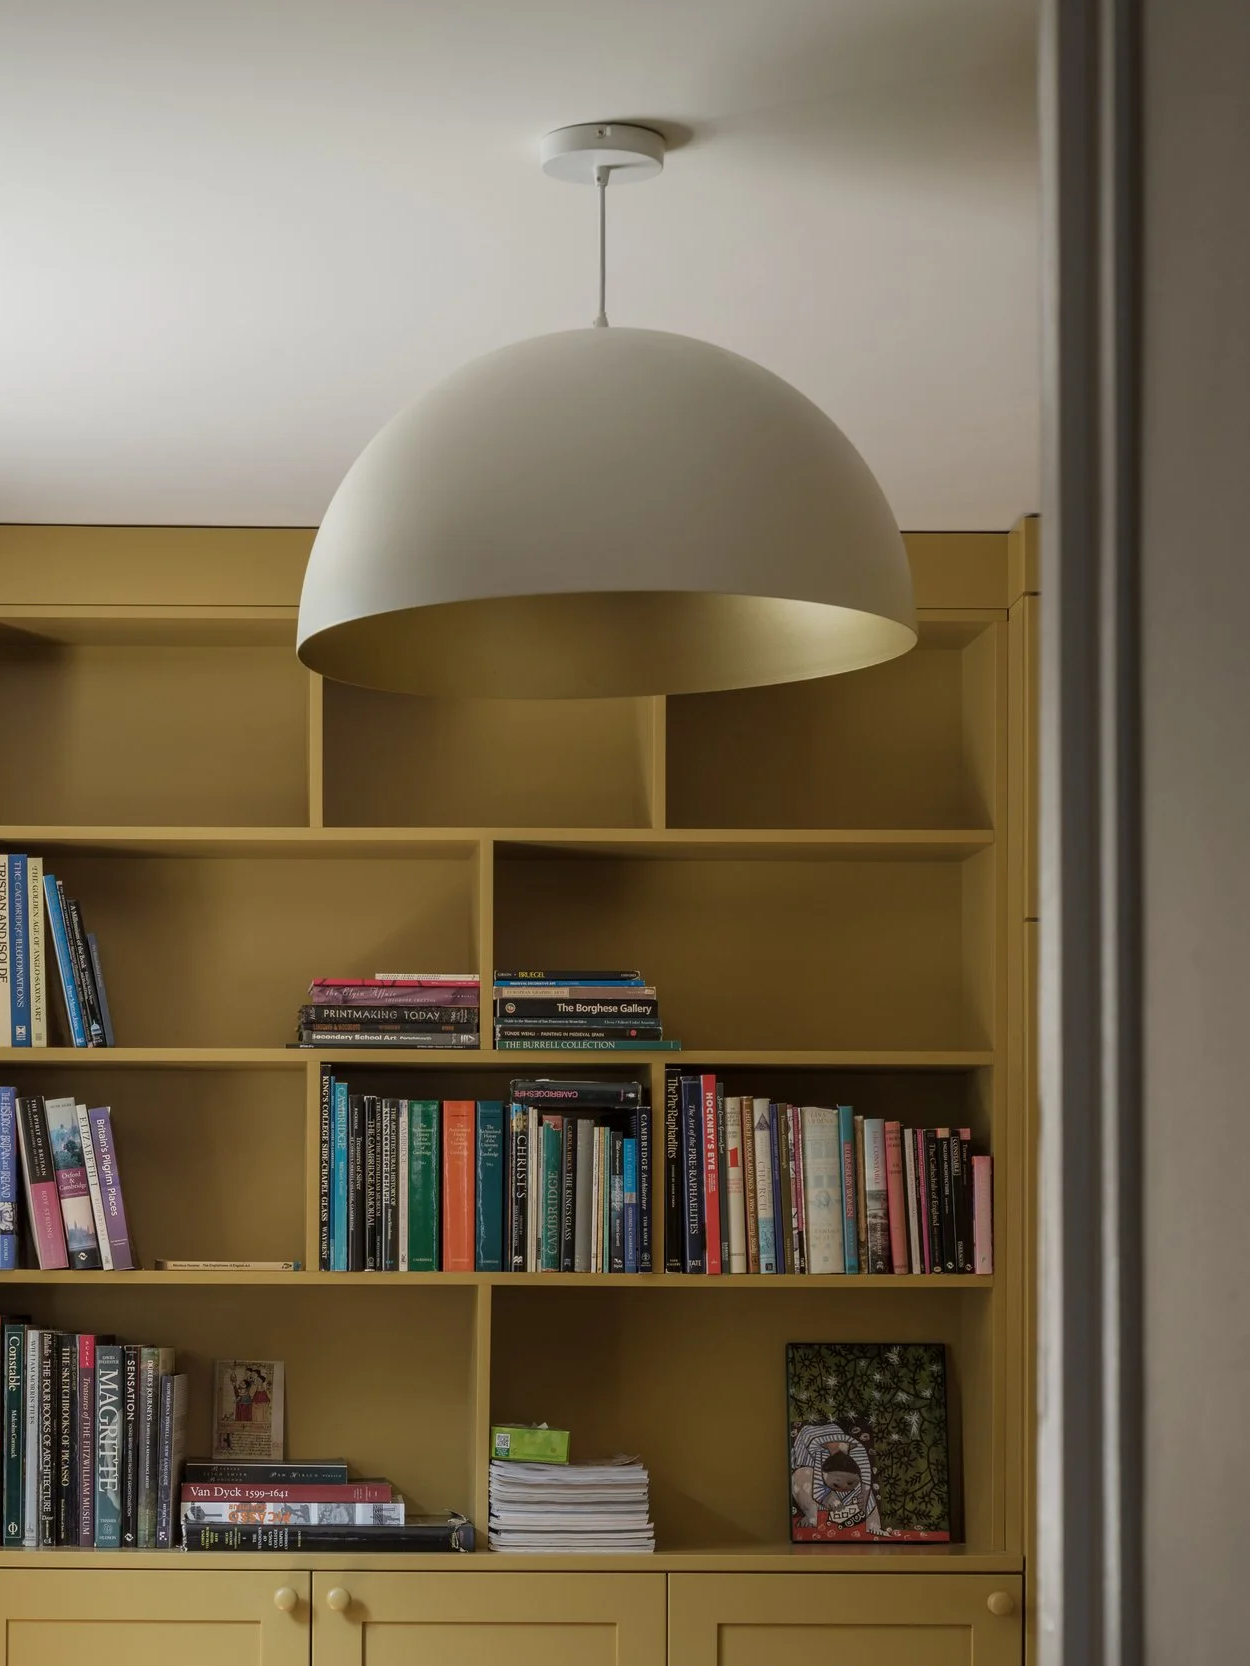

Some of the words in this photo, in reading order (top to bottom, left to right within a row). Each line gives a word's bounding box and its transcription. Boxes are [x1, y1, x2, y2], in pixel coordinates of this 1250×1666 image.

[70, 911, 80, 940] Millennium
[32, 936, 40, 946] OF
[324, 1009, 398, 1018] PRINTMAKING
[404, 1012, 440, 1020] TODAY
[556, 1004, 574, 1012] The
[576, 1004, 618, 1014] Borghese
[620, 1004, 652, 1014] Gallery
[514, 1090, 578, 1098] CAMBRIDGESHIRE
[668, 1077, 678, 1093] The
[33, 1114, 41, 1137] SPIRIT
[337, 1088, 346, 1149] CAMBRIDGE
[666, 1094, 678, 1158] Pre-Raphaelites
[688, 1128, 696, 1136] of
[706, 1092, 714, 1150] HOCKNEY'S
[36, 1138, 42, 1148] OF
[80, 1117, 96, 1178] ELIZABETH
[97, 1119, 108, 1152] Britain's
[689, 1137, 697, 1147] the
[38, 1149, 46, 1176] BRITAIN
[100, 1154, 113, 1186] Pilgrim
[517, 1135, 527, 1199] CHRIST'S
[108, 1188, 118, 1216] Places
[390, 1198, 396, 1206] OF
[689, 1148, 698, 1234] PRE-RAPHAELITES
[44, 1208, 54, 1239] STRONG
[546, 1171, 558, 1255] CAMBRIDGE
[748, 1214, 756, 1236] Country
[932, 1200, 940, 1226] England
[8, 1336, 20, 1392] Constable
[42, 1360, 50, 1377] THE
[62, 1346, 70, 1366] THE
[42, 1379, 50, 1402] FOUR
[61, 1367, 70, 1434] SKETCHBOOKS
[82, 1377, 90, 1411] Treasures
[126, 1360, 134, 1420] SENSATION
[42, 1403, 50, 1434] BOOKS
[82, 1412, 91, 1420] of
[82, 1422, 90, 1438] THE
[42, 1434, 50, 1447] OF
[61, 1435, 70, 1448] OF
[98, 1369, 118, 1492] MAGRITTE
[42, 1448, 50, 1512] ARCHITECTURE
[60, 1450, 70, 1487] PICASSO
[82, 1441, 90, 1496] FITZWILLIAM
[190, 1487, 210, 1497] Van
[214, 1487, 242, 1499] Dyck
[82, 1498, 90, 1536] MUSEUM
